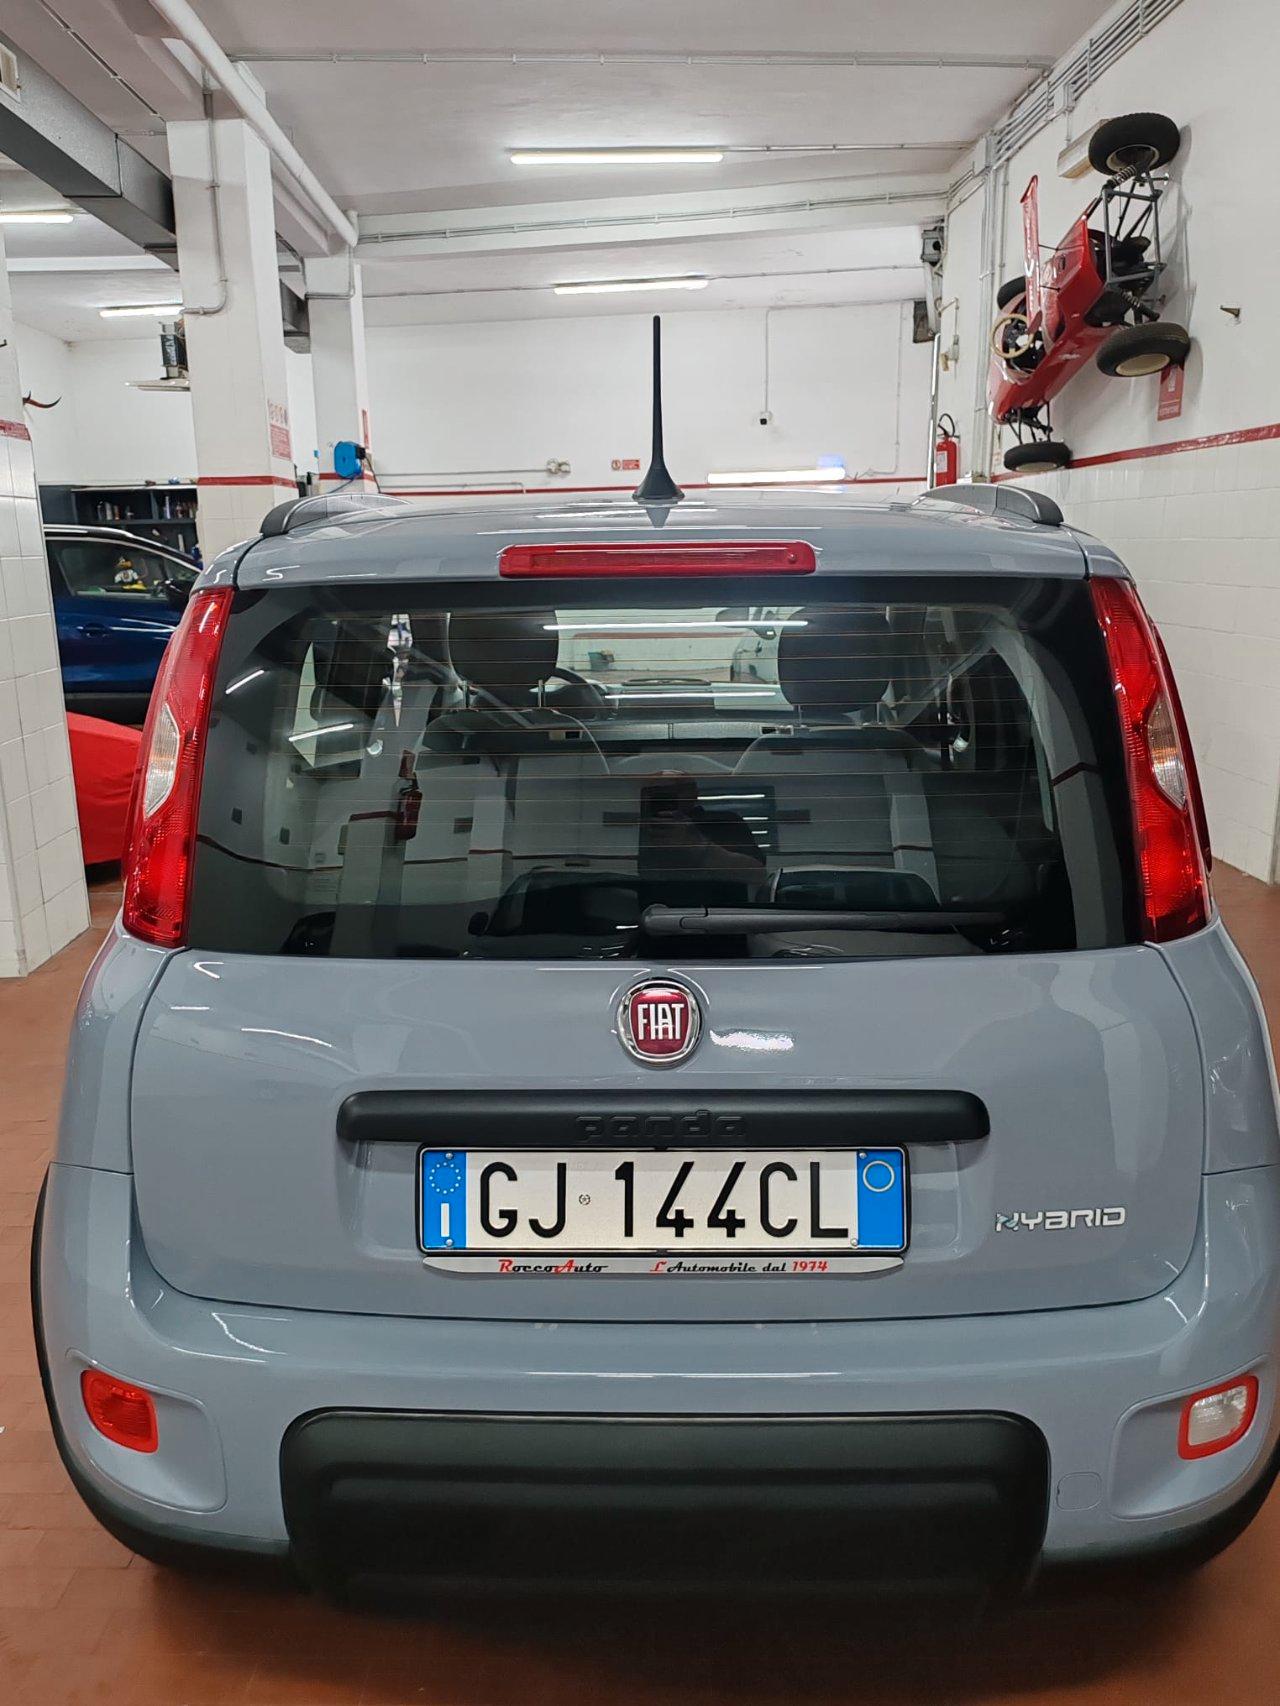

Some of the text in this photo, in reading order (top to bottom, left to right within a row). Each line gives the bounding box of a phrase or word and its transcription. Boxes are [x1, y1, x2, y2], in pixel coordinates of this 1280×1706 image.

[637, 1003, 685, 1040] FIAT
[576, 1109, 747, 1144] panda
[996, 1207, 1126, 1232] HYBRID
[762, 1261, 787, 1272] dal
[792, 1260, 829, 1273] 1974
